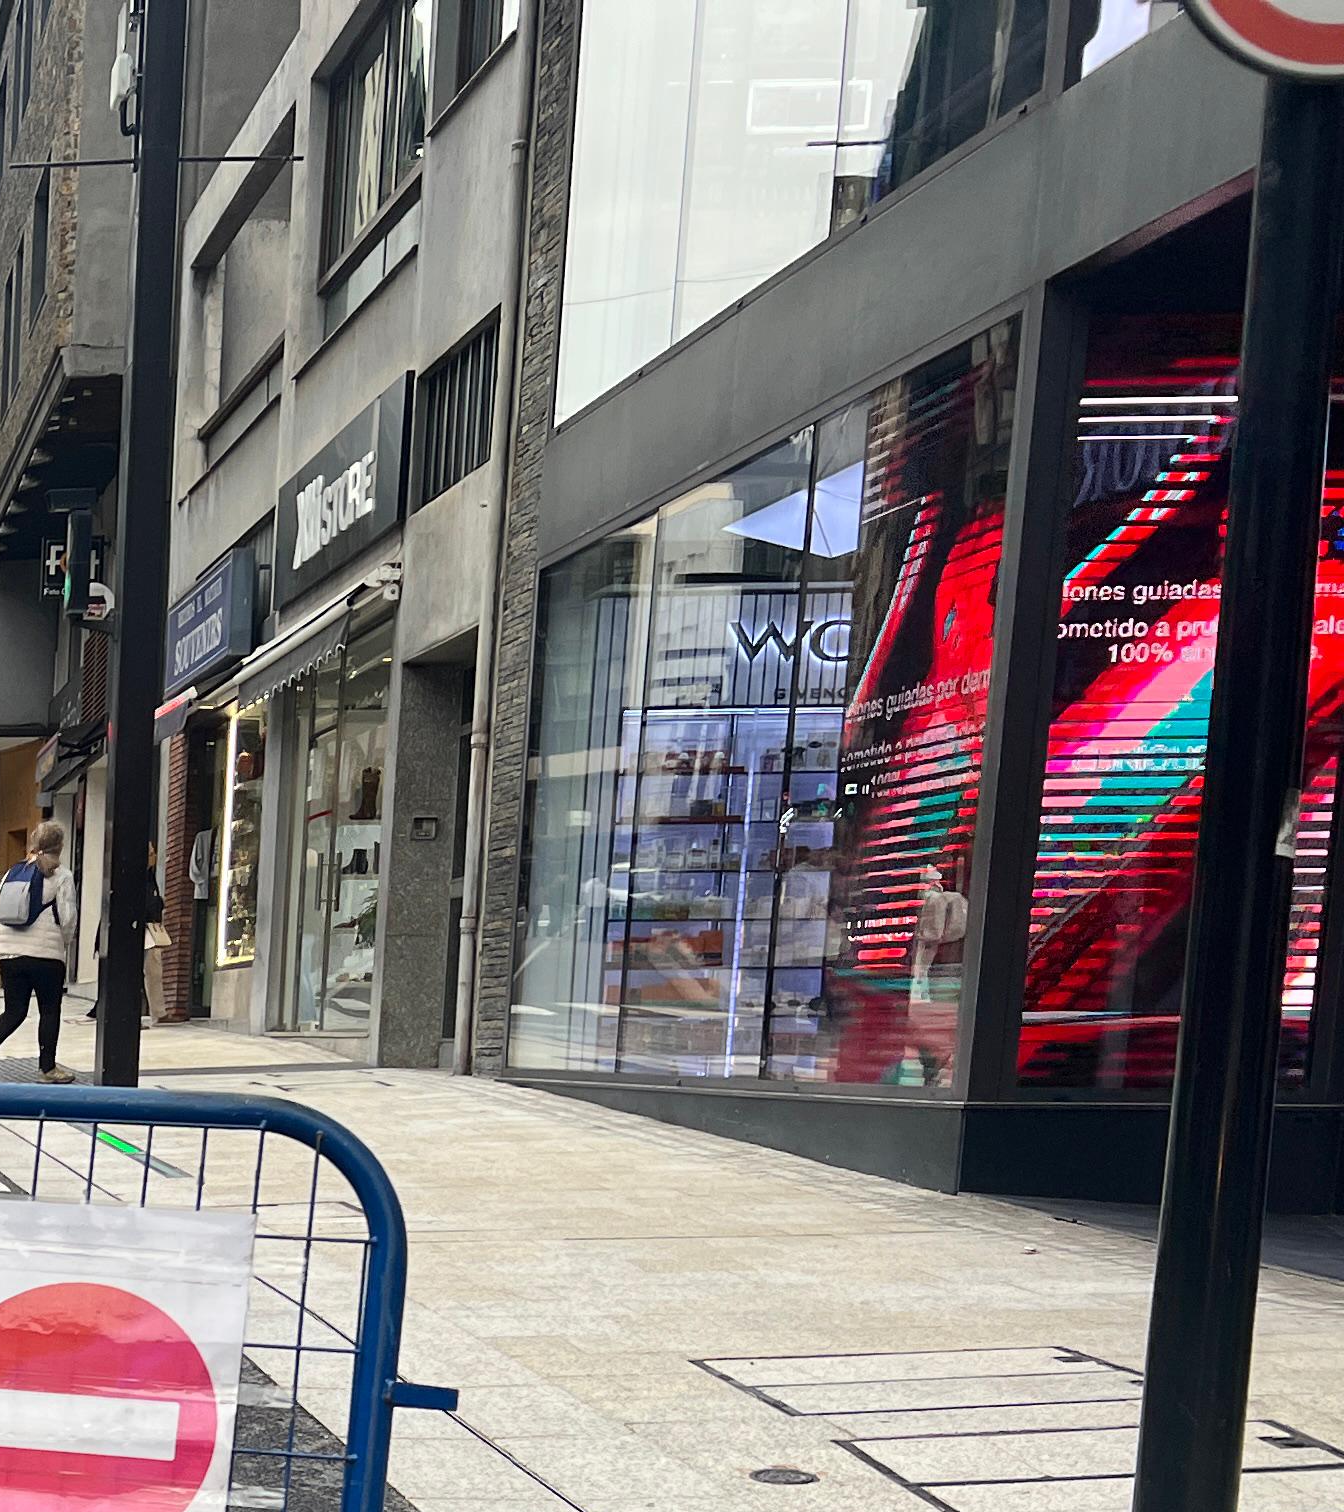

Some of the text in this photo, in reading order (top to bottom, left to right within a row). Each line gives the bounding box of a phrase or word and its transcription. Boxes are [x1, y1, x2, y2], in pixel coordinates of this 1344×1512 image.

[1133, 579, 1222, 605] guiadas
[1155, 620, 1171, 638] a
[1109, 643, 1174, 663] 100%
